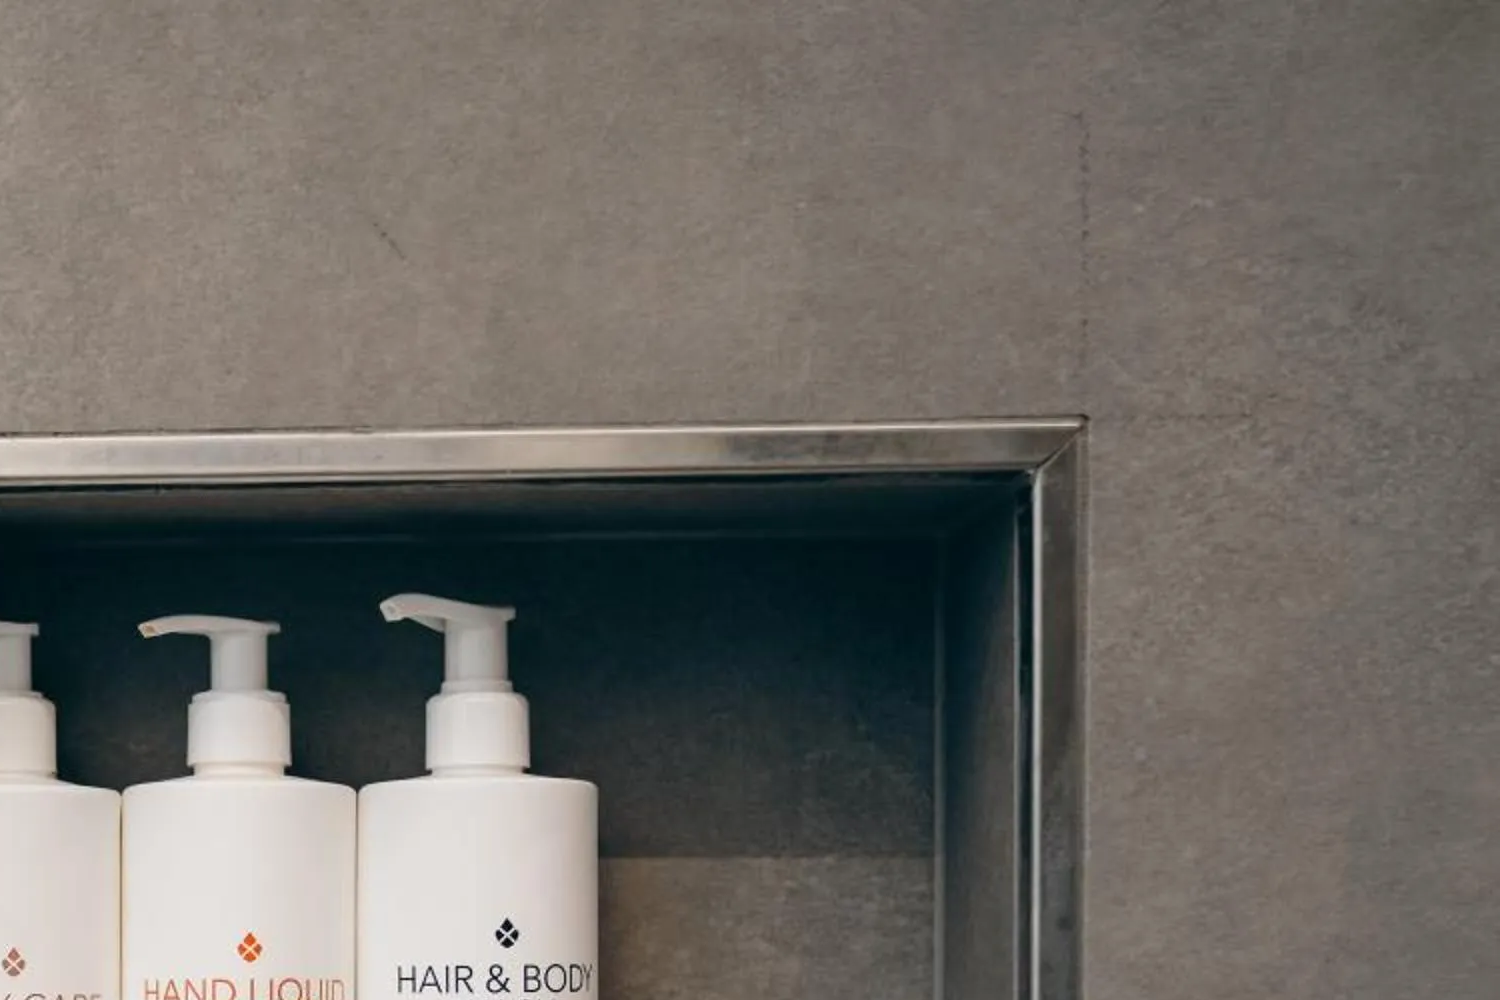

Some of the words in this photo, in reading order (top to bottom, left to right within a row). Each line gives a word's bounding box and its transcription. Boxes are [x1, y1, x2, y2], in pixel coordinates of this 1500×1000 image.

[397, 964, 474, 994] HAIR
[485, 963, 511, 995] &
[522, 963, 594, 994] BODY
